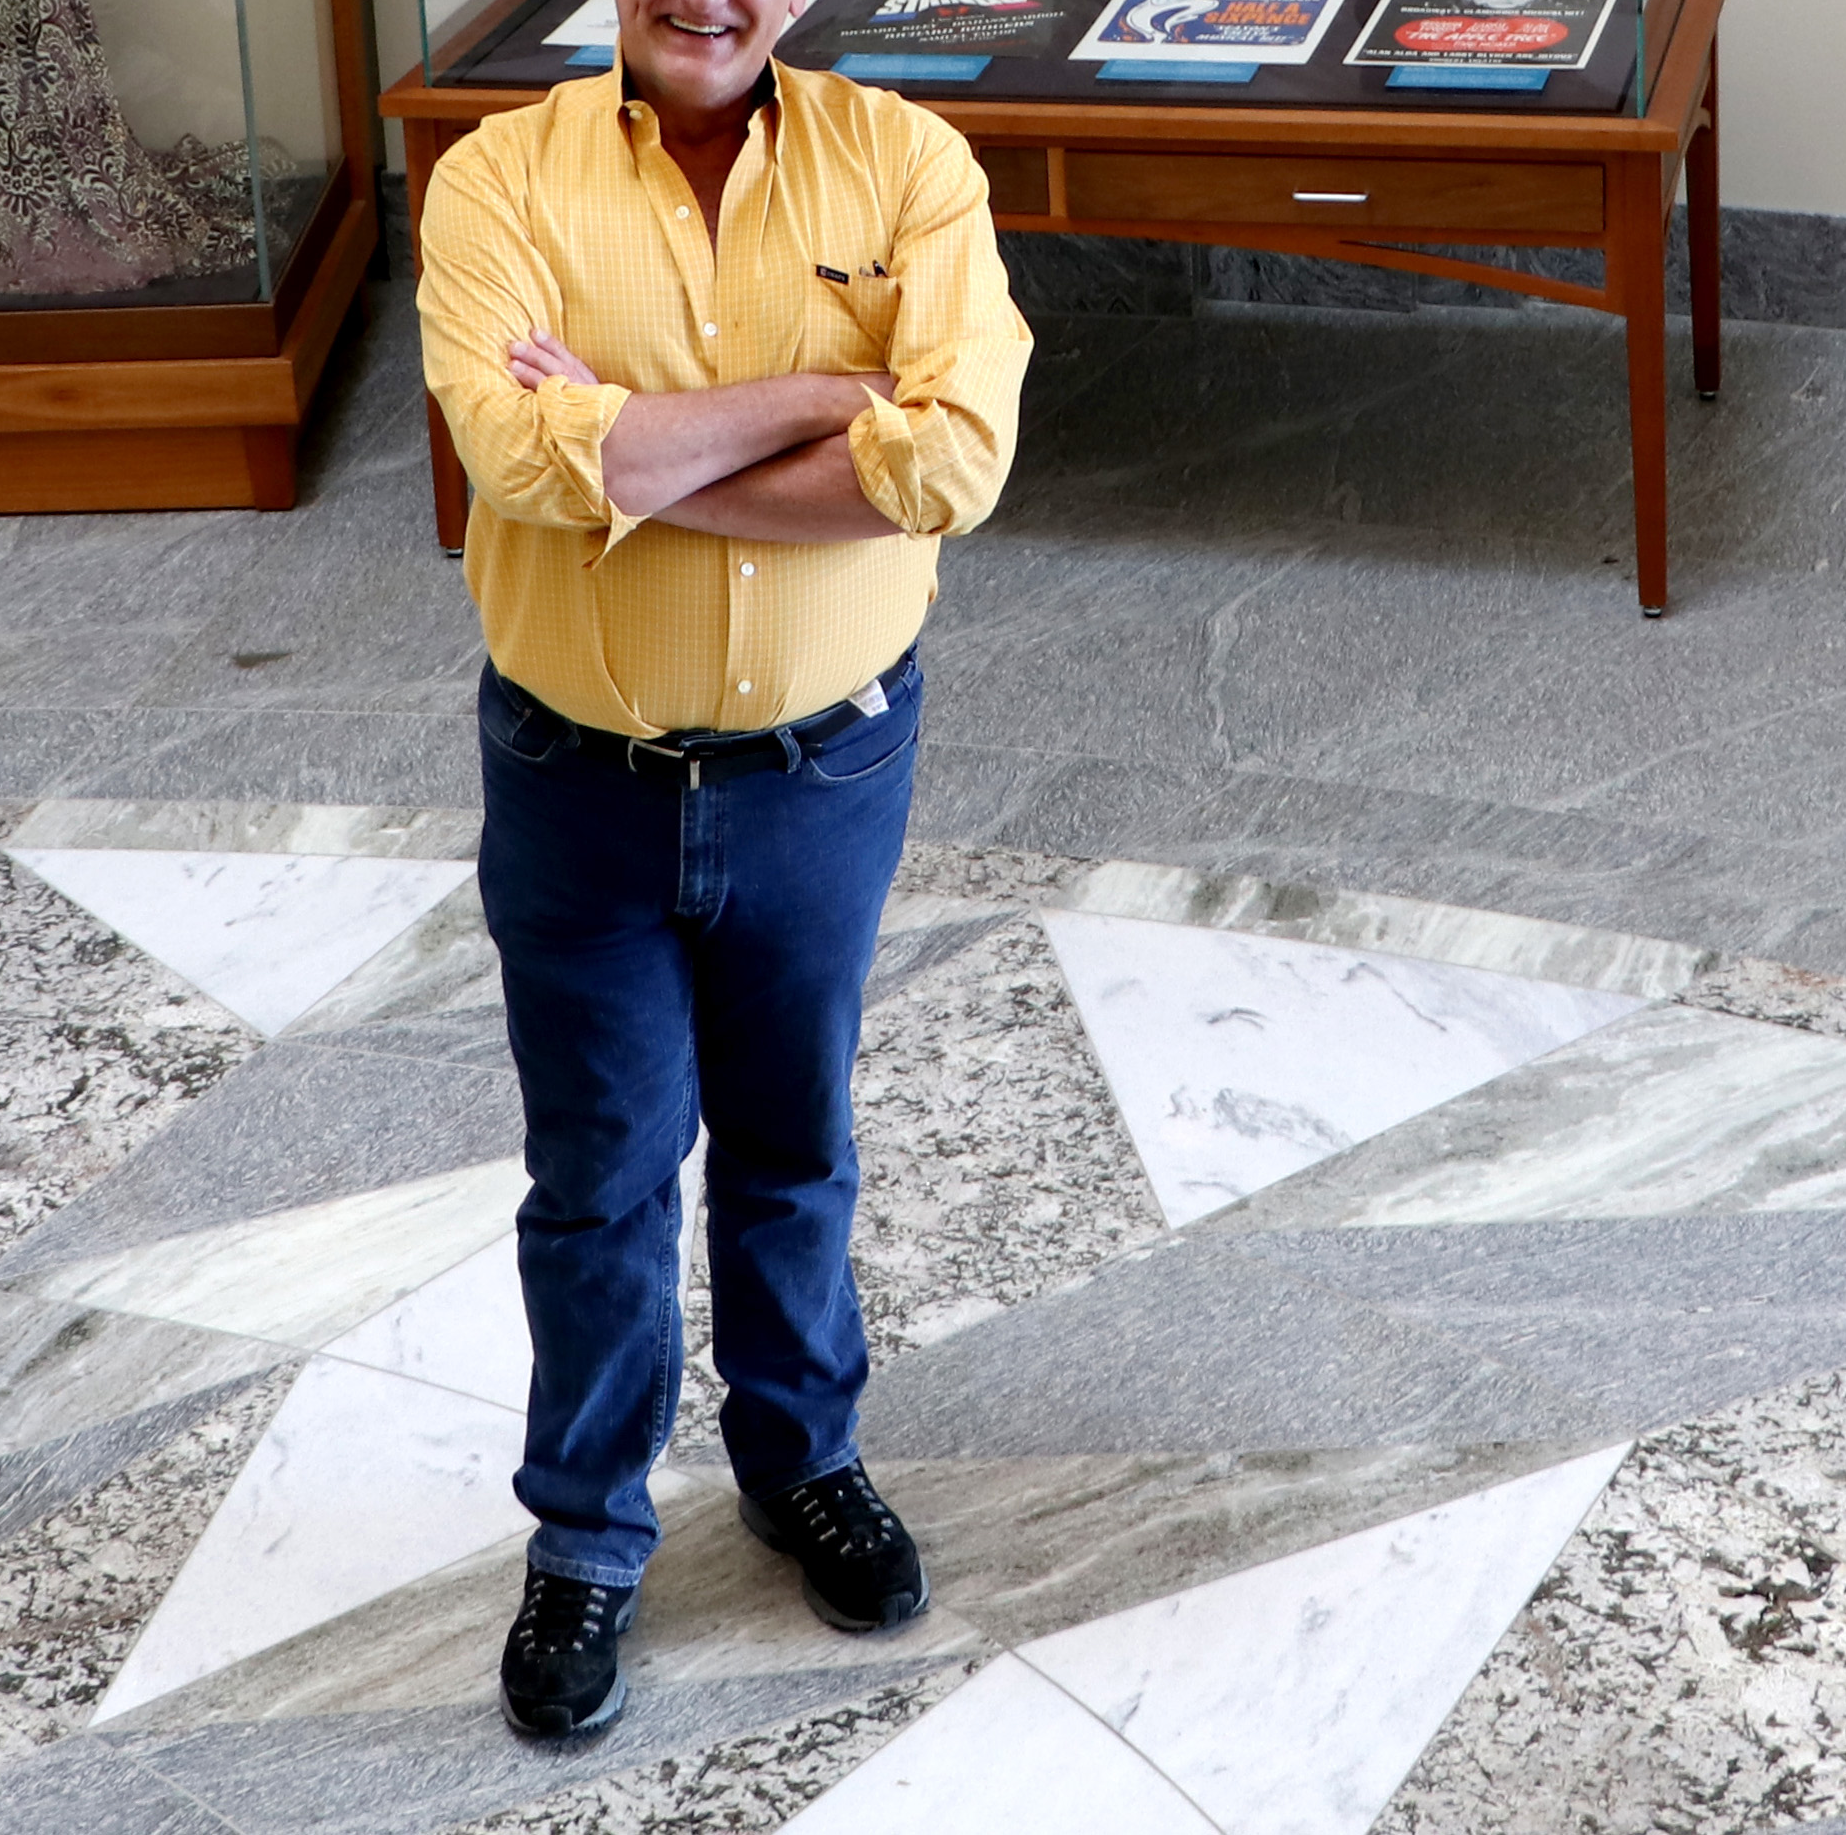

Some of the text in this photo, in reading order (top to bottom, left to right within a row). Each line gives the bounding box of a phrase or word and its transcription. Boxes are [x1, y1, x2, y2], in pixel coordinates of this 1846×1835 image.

[1226, 2, 1301, 13] HALF A
[1204, 12, 1312, 26] SIXPENCE
